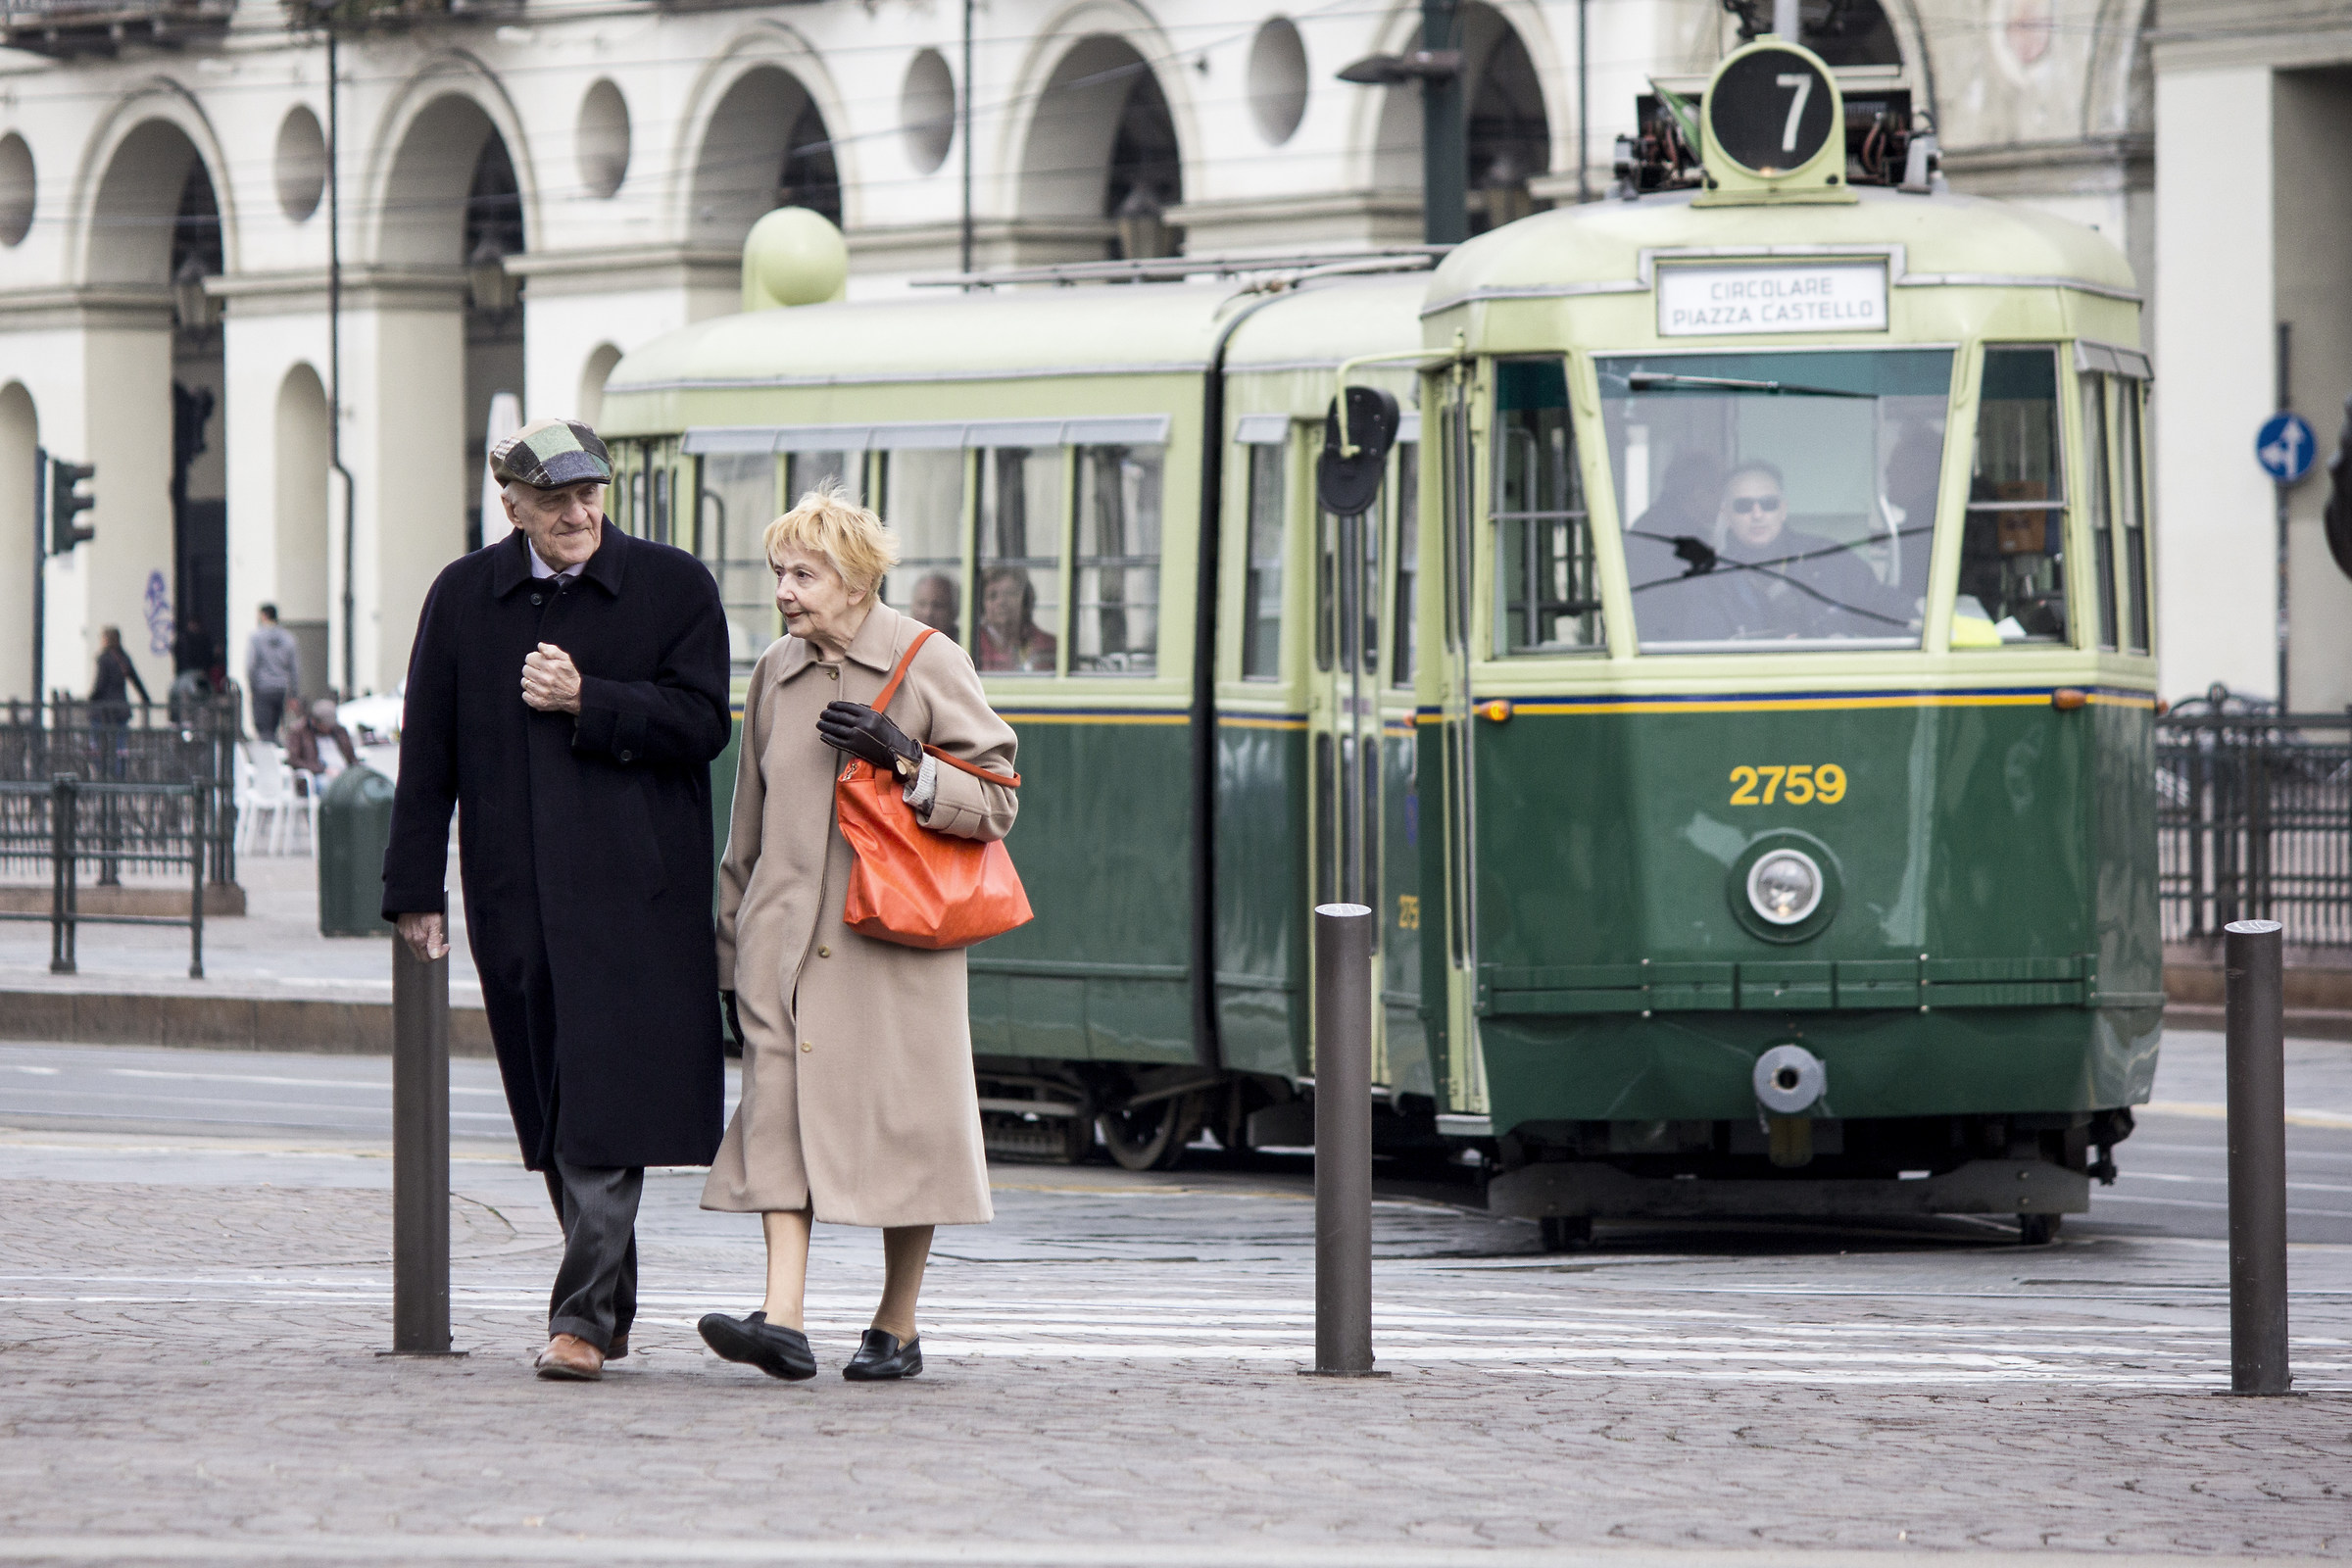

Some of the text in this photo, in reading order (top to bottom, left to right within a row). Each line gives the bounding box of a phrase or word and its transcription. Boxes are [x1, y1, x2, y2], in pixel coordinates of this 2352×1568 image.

[1776, 74, 1812, 152] 7
[1711, 276, 1834, 300] CIRCOLARE
[1673, 300, 1874, 326] PIAZZA CASTELLO
[1730, 763, 1847, 805] 2759
